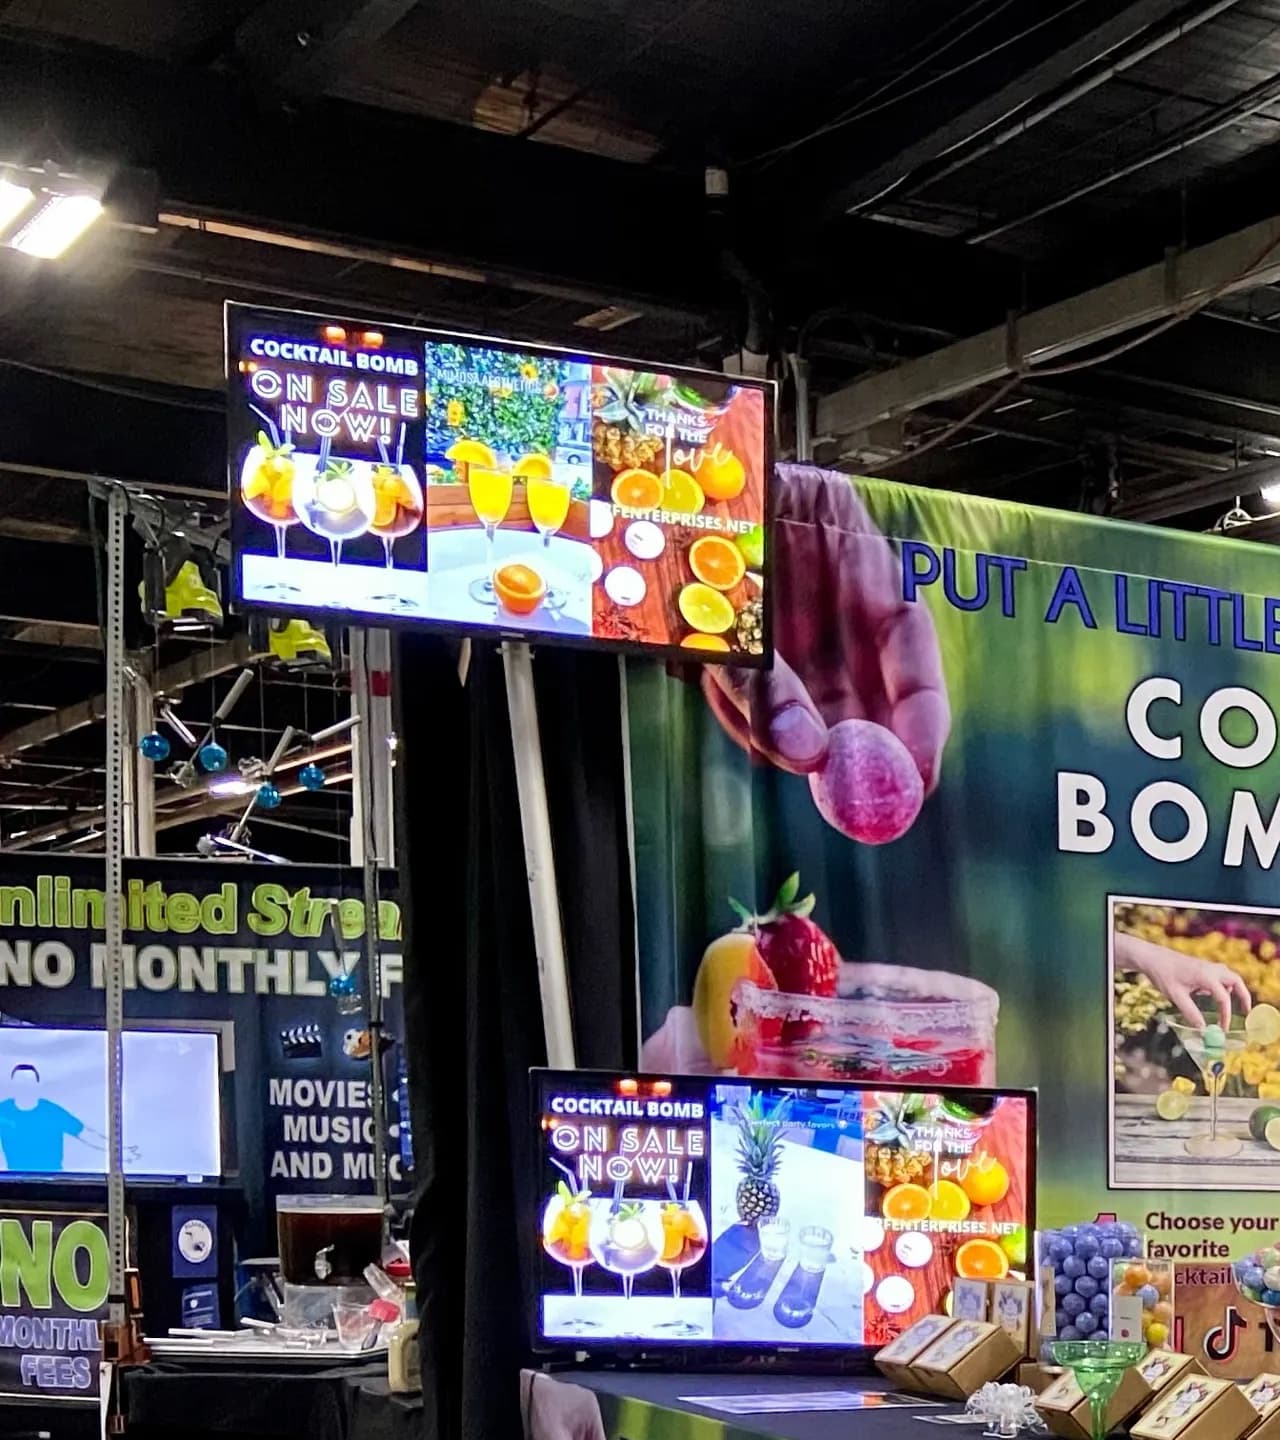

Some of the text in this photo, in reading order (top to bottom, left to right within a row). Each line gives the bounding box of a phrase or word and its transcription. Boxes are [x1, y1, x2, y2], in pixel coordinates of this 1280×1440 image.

[250, 338, 418, 376] COCKTAIL BOMB
[251, 369, 419, 418] ON SALE
[281, 403, 391, 445] NOW!
[647, 408, 706, 427] THANKS
[645, 423, 708, 443] FOR THE
[903, 541, 1027, 618] PUT
[1045, 566, 1097, 629] A
[0, 940, 76, 989] NO
[90, 942, 361, 996] MONTHLY
[551, 1097, 704, 1118] COCKTAIL BOMB
[552, 1125, 704, 1155] ON SALE
[916, 1126, 971, 1140] THANKS
[946, 1139, 973, 1153] THE
[271, 1151, 333, 1180] AND
[579, 1153, 678, 1184] NOW!
[1145, 1212, 1279, 1233] Choose your
[1147, 1239, 1230, 1258] favorite
[0, 1219, 111, 1312] NO
[1174, 1268, 1233, 1286] cktail
[20, 1354, 91, 1389] FEES
